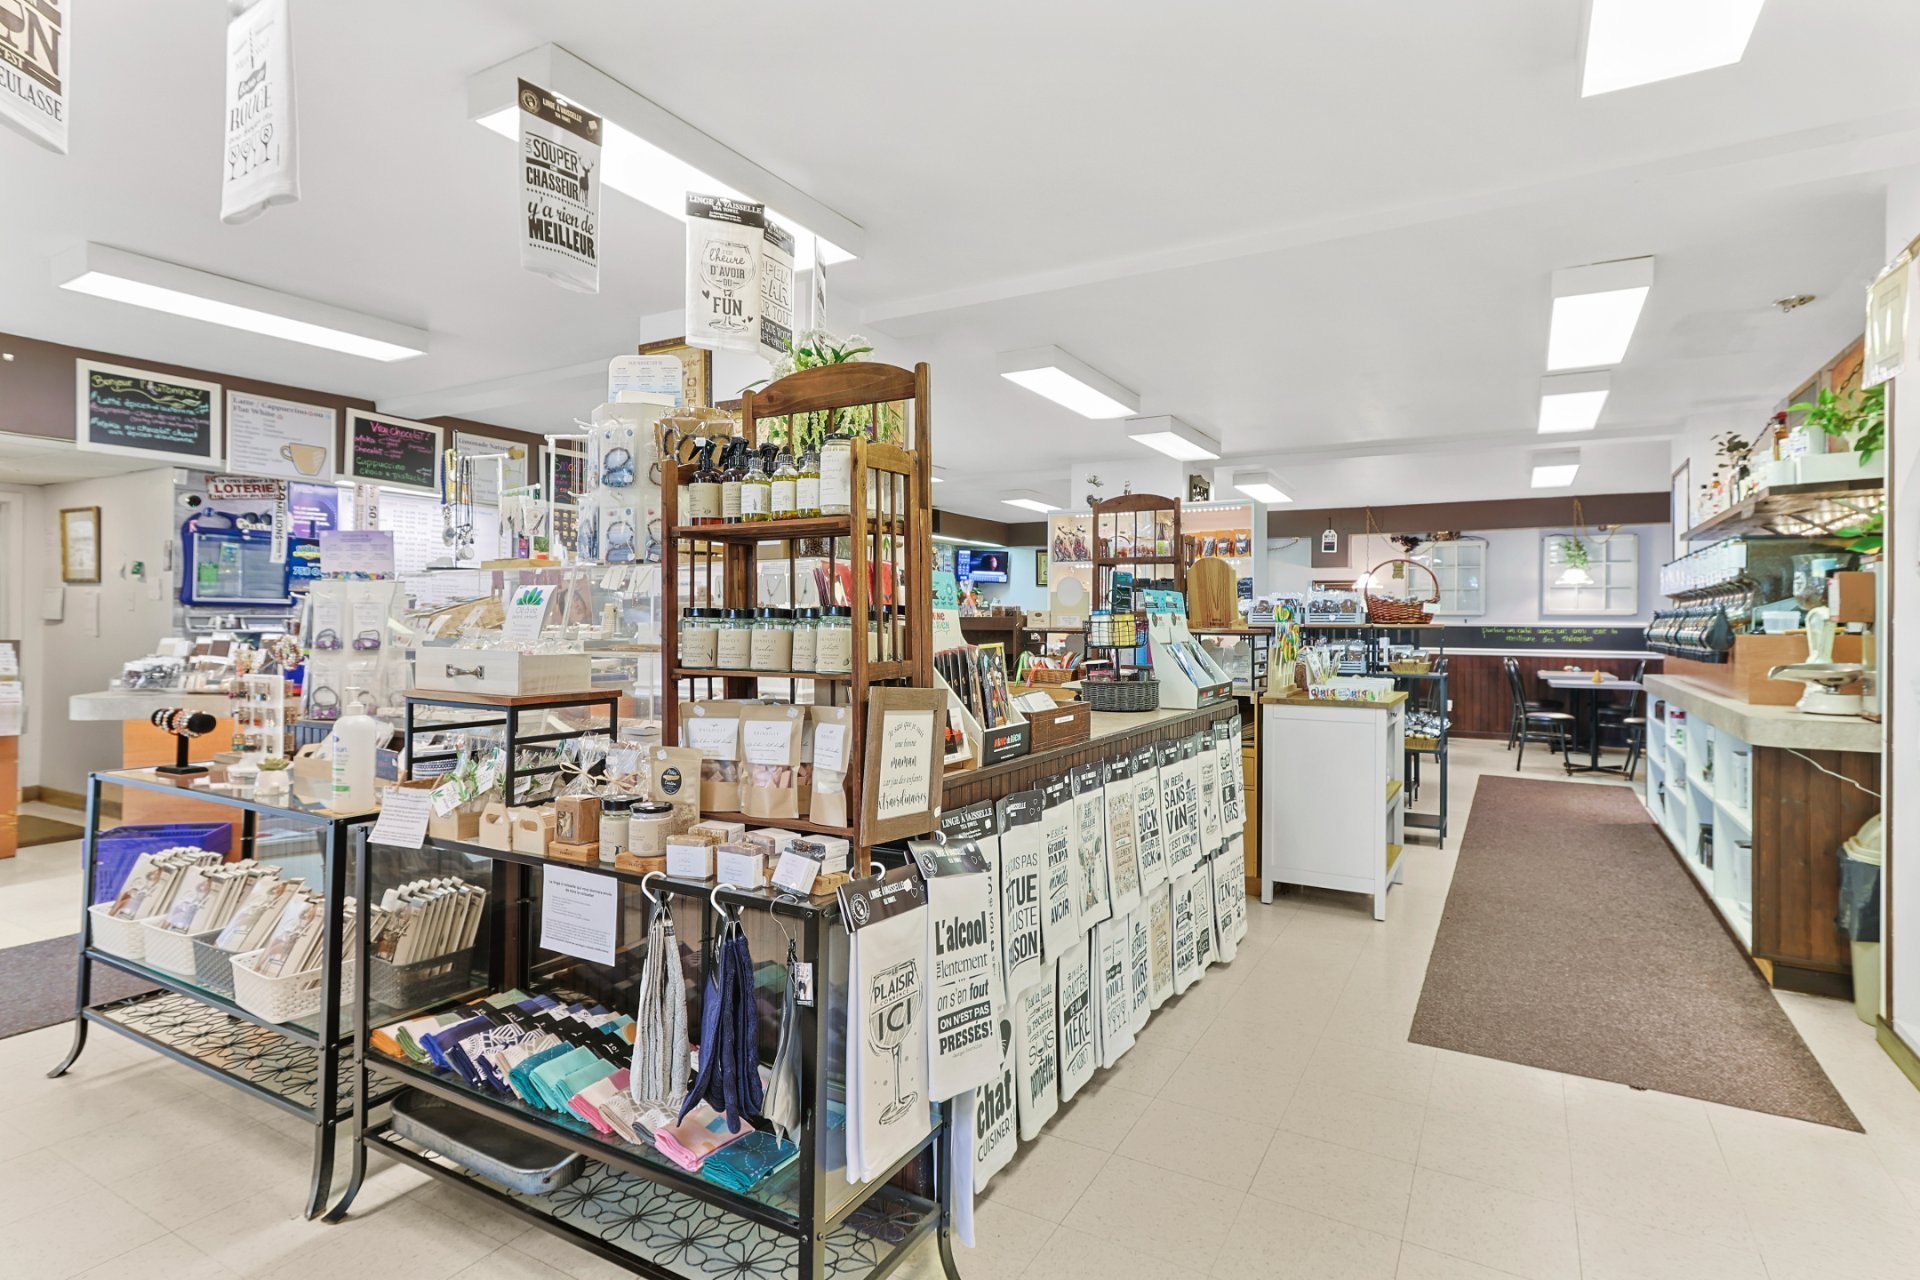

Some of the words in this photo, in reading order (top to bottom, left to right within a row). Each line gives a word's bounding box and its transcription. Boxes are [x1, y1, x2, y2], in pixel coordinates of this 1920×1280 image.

[533, 138, 579, 174] SOUPER
[526, 166, 580, 202] CHASSEUR
[689, 195, 714, 206] LINGE
[723, 201, 762, 214] VAISSELLE
[556, 206, 579, 229] rien
[580, 214, 595, 236] de
[527, 215, 595, 260] MEILLEUR
[709, 247, 746, 265] l'heure
[710, 265, 745, 279] D'AVOIR
[215, 484, 274, 493] LOTERIE
[1164, 783, 1186, 810] SANS
[941, 815, 961, 829] LINGE
[966, 807, 993, 821] VAISSELLE
[1166, 803, 1188, 835] VIN
[1021, 853, 1038, 870] PAS
[1048, 848, 1068, 868] PAPA
[935, 911, 988, 956] L'alcool
[941, 953, 988, 978] lentement
[874, 970, 915, 1004] PLAISIR
[937, 995, 948, 1012] on
[949, 987, 968, 1009] s'en
[969, 979, 989, 1001] fout
[879, 997, 911, 1041] ICI
[939, 1015, 952, 1031] ON
[953, 1009, 973, 1026] N'EST
[974, 1002, 990, 1018] PAS
[939, 1018, 993, 1056] PRESSÉS!
[1064, 1005, 1091, 1060] MÈRE
